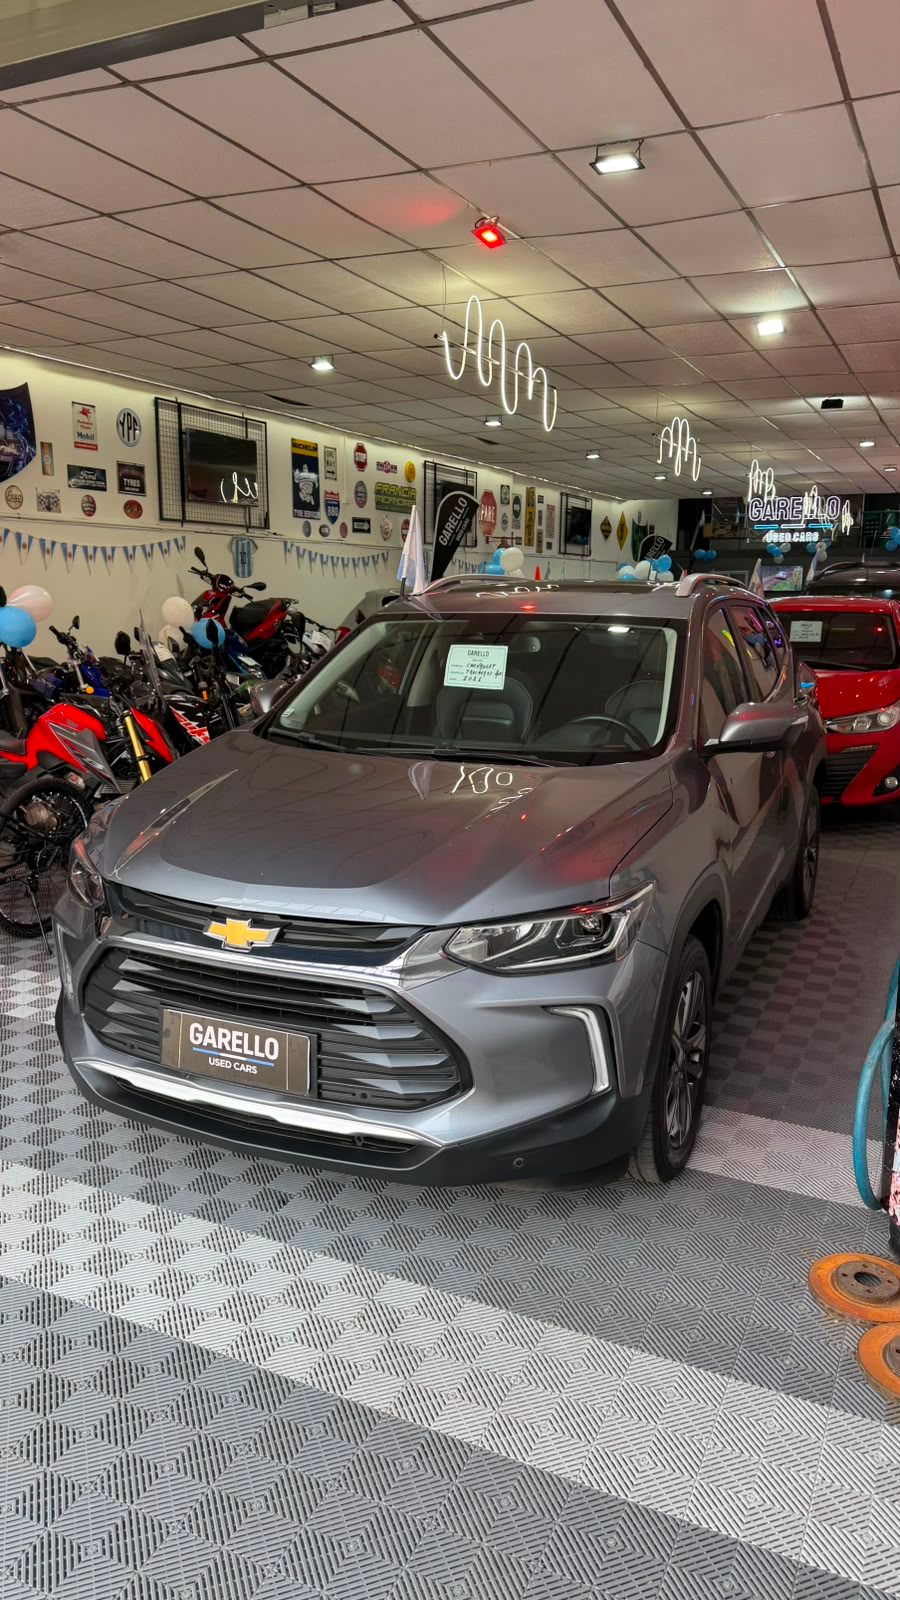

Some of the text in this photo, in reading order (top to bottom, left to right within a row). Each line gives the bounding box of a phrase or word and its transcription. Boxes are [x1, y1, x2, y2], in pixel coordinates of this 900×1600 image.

[119, 412, 139, 442] YPF
[77, 431, 95, 441] Mobil
[292, 442, 318, 452] MICHELIN
[326, 449, 335, 458] ONE
[355, 452, 367, 463] STOP
[80, 470, 97, 480] Ford
[123, 478, 140, 487] TYRES
[375, 483, 417, 498] FRANCIA
[480, 504, 496, 523] PARE
[750, 496, 841, 521] GARELLO
[438, 497, 468, 546] GARELLO
[765, 531, 819, 543] USED CARS
[189, 1022, 280, 1060] GARELLO
[208, 1056, 258, 1075] USED CARS
